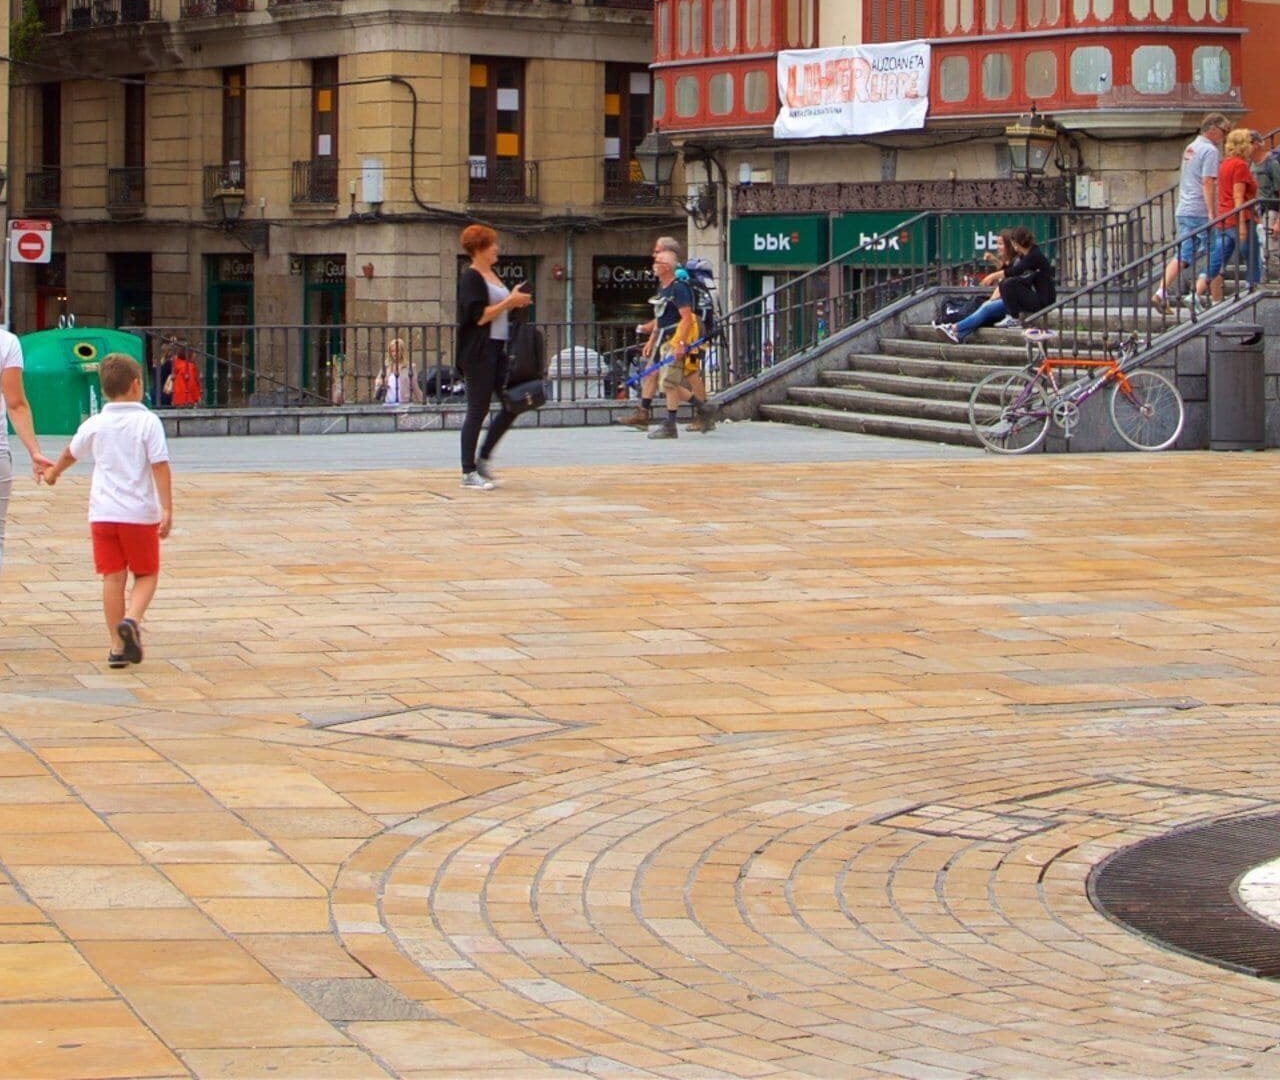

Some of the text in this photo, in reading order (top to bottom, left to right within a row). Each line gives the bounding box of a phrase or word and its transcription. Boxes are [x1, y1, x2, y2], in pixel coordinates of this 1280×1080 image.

[753, 233, 791, 251] bbk
[859, 232, 900, 251] bbk
[974, 231, 1000, 250] bb
